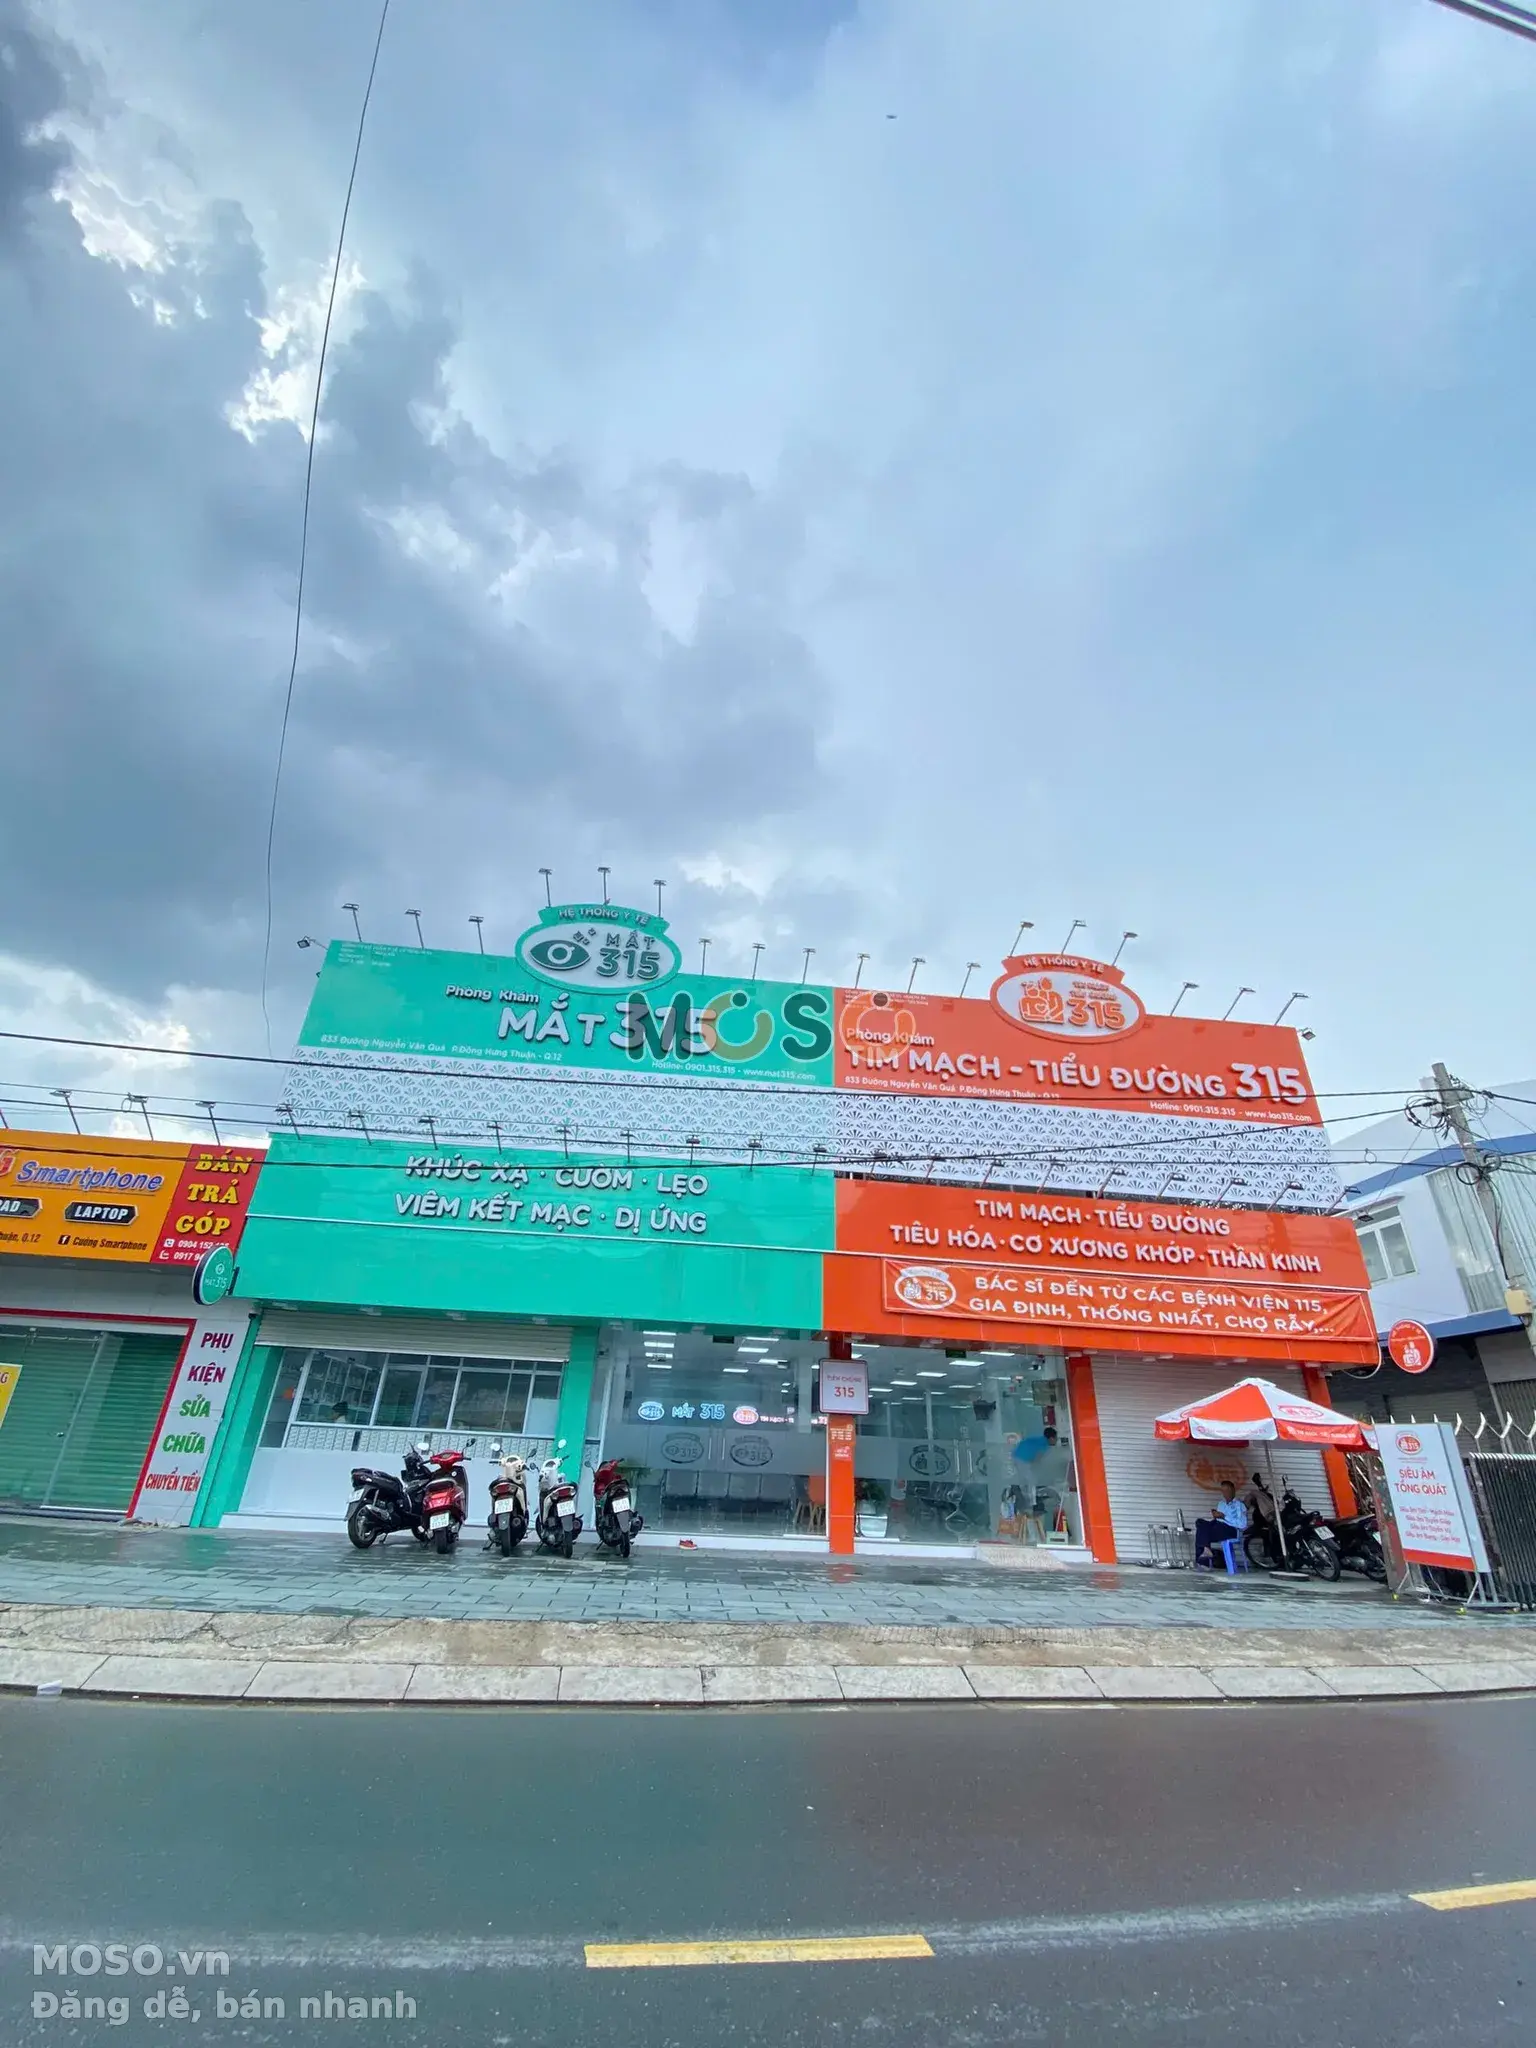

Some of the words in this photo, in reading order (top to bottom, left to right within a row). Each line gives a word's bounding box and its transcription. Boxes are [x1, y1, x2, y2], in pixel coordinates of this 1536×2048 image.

[624, 911, 630, 920] Y
[596, 947, 660, 980] 315
[445, 984, 492, 1001] Phòng
[499, 989, 540, 1004] Khám
[498, 991, 605, 1046] MẮT
[609, 1000, 718, 1055] 315
[1067, 999, 1126, 1031] 315
[846, 1027, 892, 1044] Phòng
[845, 1044, 900, 1069] TIM
[909, 1050, 1001, 1083] MẠCH
[1029, 1051, 1101, 1088] TIỂU
[1110, 1064, 1228, 1098] ĐƯỜNG
[1231, 1062, 1307, 1106] 315
[195, 1148, 254, 1175] BÁN
[16, 1160, 164, 1192] Smartphone
[405, 1153, 483, 1181] KHÚC
[490, 1161, 529, 1189] XẠ
[656, 1172, 708, 1199] LẸO
[187, 1178, 239, 1205] TRẢ
[74, 1205, 129, 1220] LAPTOP
[175, 1210, 231, 1236] GÓP
[395, 1190, 462, 1218] VIÊM
[467, 1191, 523, 1222] KẾT
[530, 1203, 592, 1231] MẠC
[615, 1207, 641, 1234] DỊ
[649, 1203, 708, 1233] ỨNG
[975, 1199, 1013, 1219] TIM
[1020, 1203, 1082, 1227] MẠCH
[1095, 1203, 1143, 1230] TIỂU
[1151, 1210, 1231, 1236] ĐƯỜNG
[99, 1238, 148, 1250] Smartphone
[890, 1220, 939, 1246] TIÊU
[947, 1225, 997, 1250] HÓA
[1009, 1234, 1043, 1254] CƠ
[1050, 1237, 1129, 1261] XƯƠNG
[1135, 1240, 1196, 1266] KHỚP
[1207, 1243, 1266, 1270] THẦN
[1268, 1253, 1322, 1273] KINH
[173, 1252, 194, 1261] 0917
[926, 1290, 947, 1302] 315
[975, 1274, 1018, 1292] BÁC
[1024, 1278, 1043, 1294] SĨ
[1049, 1279, 1094, 1298] ĐẾN
[1100, 1284, 1127, 1300] TỪ
[1133, 1287, 1176, 1304] CÁC
[1181, 1290, 1236, 1309] BỆNH
[1241, 1294, 1289, 1313] VIỆN
[1294, 1299, 1328, 1314] 115,
[969, 1298, 1007, 1314] GIA
[1013, 1301, 1072, 1320] ĐỊNH,
[1078, 1303, 1153, 1323] THỐNG
[1158, 1306, 1219, 1328] NHẤT,
[1225, 1316, 1268, 1332] CHỢ
[200, 1332, 234, 1354] PHỤ
[187, 1362, 226, 1386] KIỆN
[834, 1386, 855, 1398] 315
[179, 1394, 211, 1418] SỬA
[671, 1402, 695, 1418] MẮT
[700, 1403, 726, 1420] 315
[162, 1432, 206, 1454] CHỮA
[1399, 1466, 1419, 1479] SIÊU
[1421, 1466, 1435, 1479] ÂM
[1394, 1479, 1420, 1494] TỔNG
[1422, 1483, 1447, 1495] QUÁT
